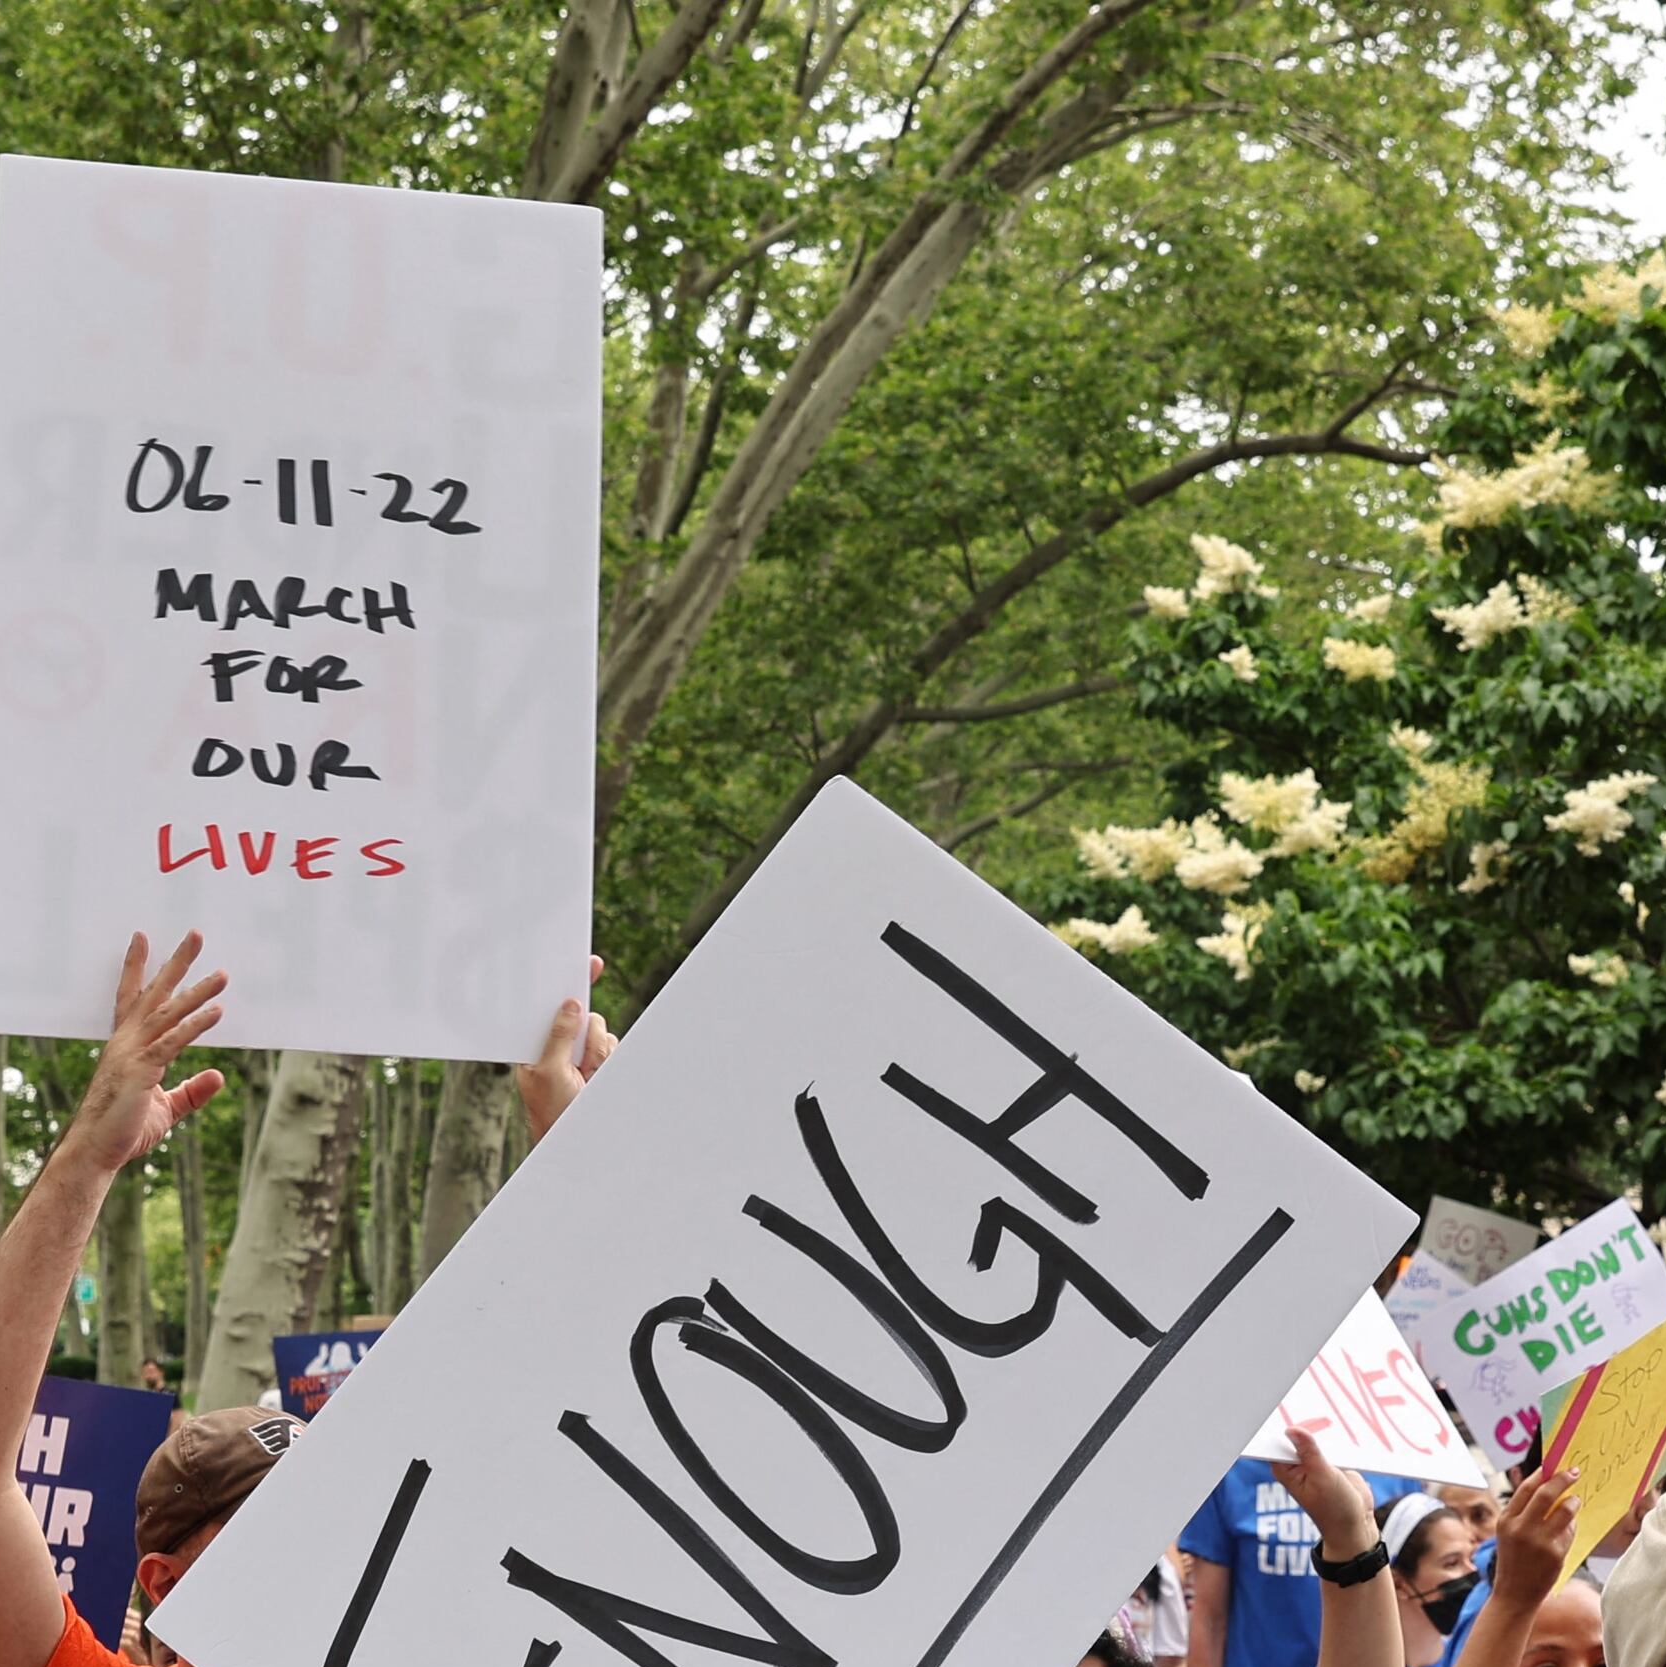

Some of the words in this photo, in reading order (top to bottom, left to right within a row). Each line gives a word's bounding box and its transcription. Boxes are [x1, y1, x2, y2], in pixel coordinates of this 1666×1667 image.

[124, 438, 483, 536] 06-11-22
[154, 568, 416, 633] MARCH
[200, 650, 364, 704] FOR
[190, 738, 382, 791] OUR
[158, 824, 406, 879] LIVES
[1453, 1285, 1548, 1356] GUNS
[1546, 1225, 1646, 1304] DON'T
[1520, 1302, 1606, 1375] DIE
